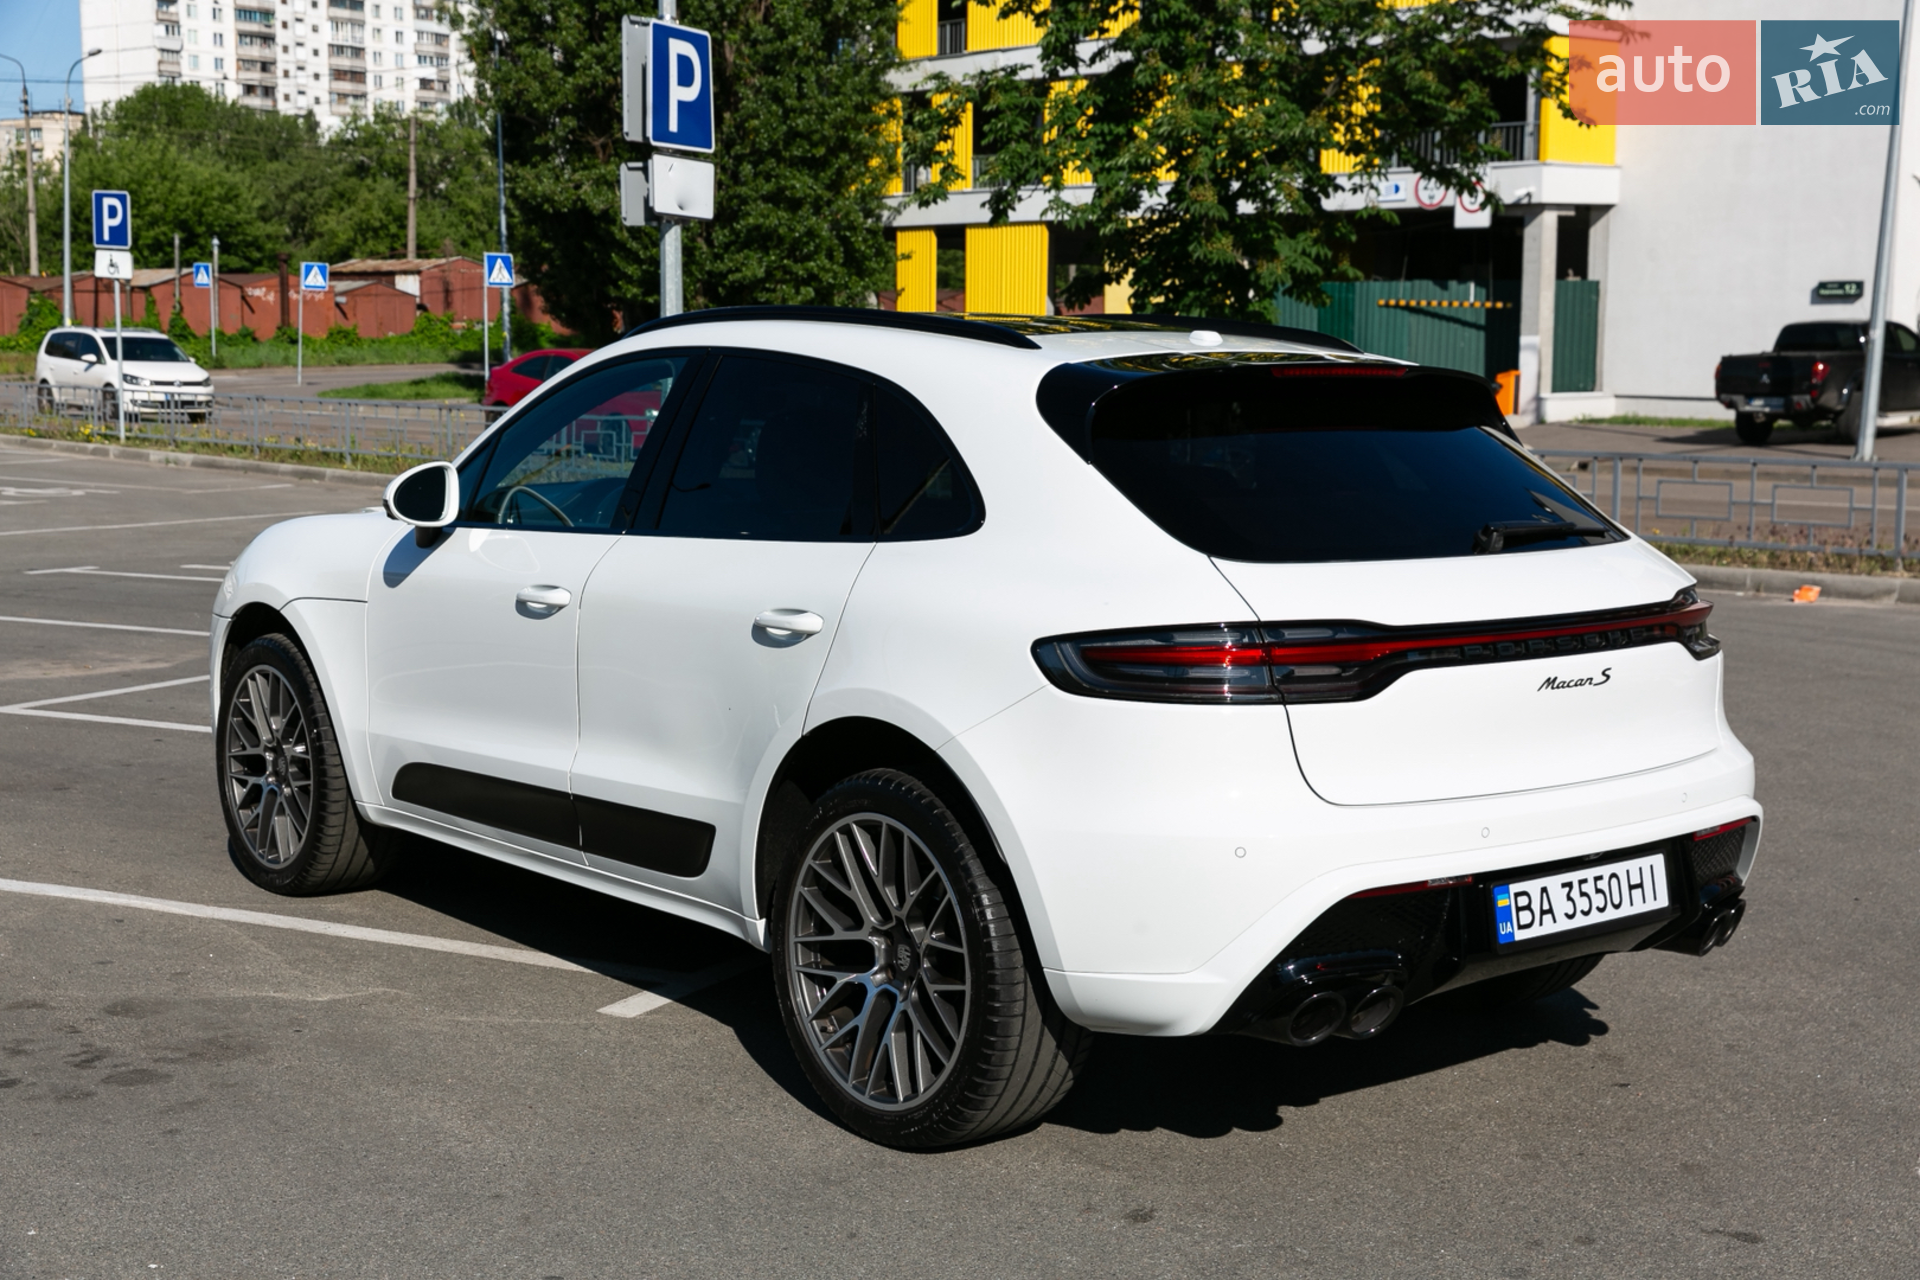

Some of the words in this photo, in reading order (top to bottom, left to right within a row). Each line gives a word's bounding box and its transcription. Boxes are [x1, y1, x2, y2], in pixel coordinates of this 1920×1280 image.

[668, 37, 702, 133] P
[102, 196, 123, 241] P
[1537, 675, 1594, 692] Macan
[1593, 667, 1612, 687] S
[1513, 886, 1557, 931] BA
[1561, 872, 1623, 920] 3550
[1626, 864, 1658, 907] HI
[1499, 921, 1513, 935] UA
